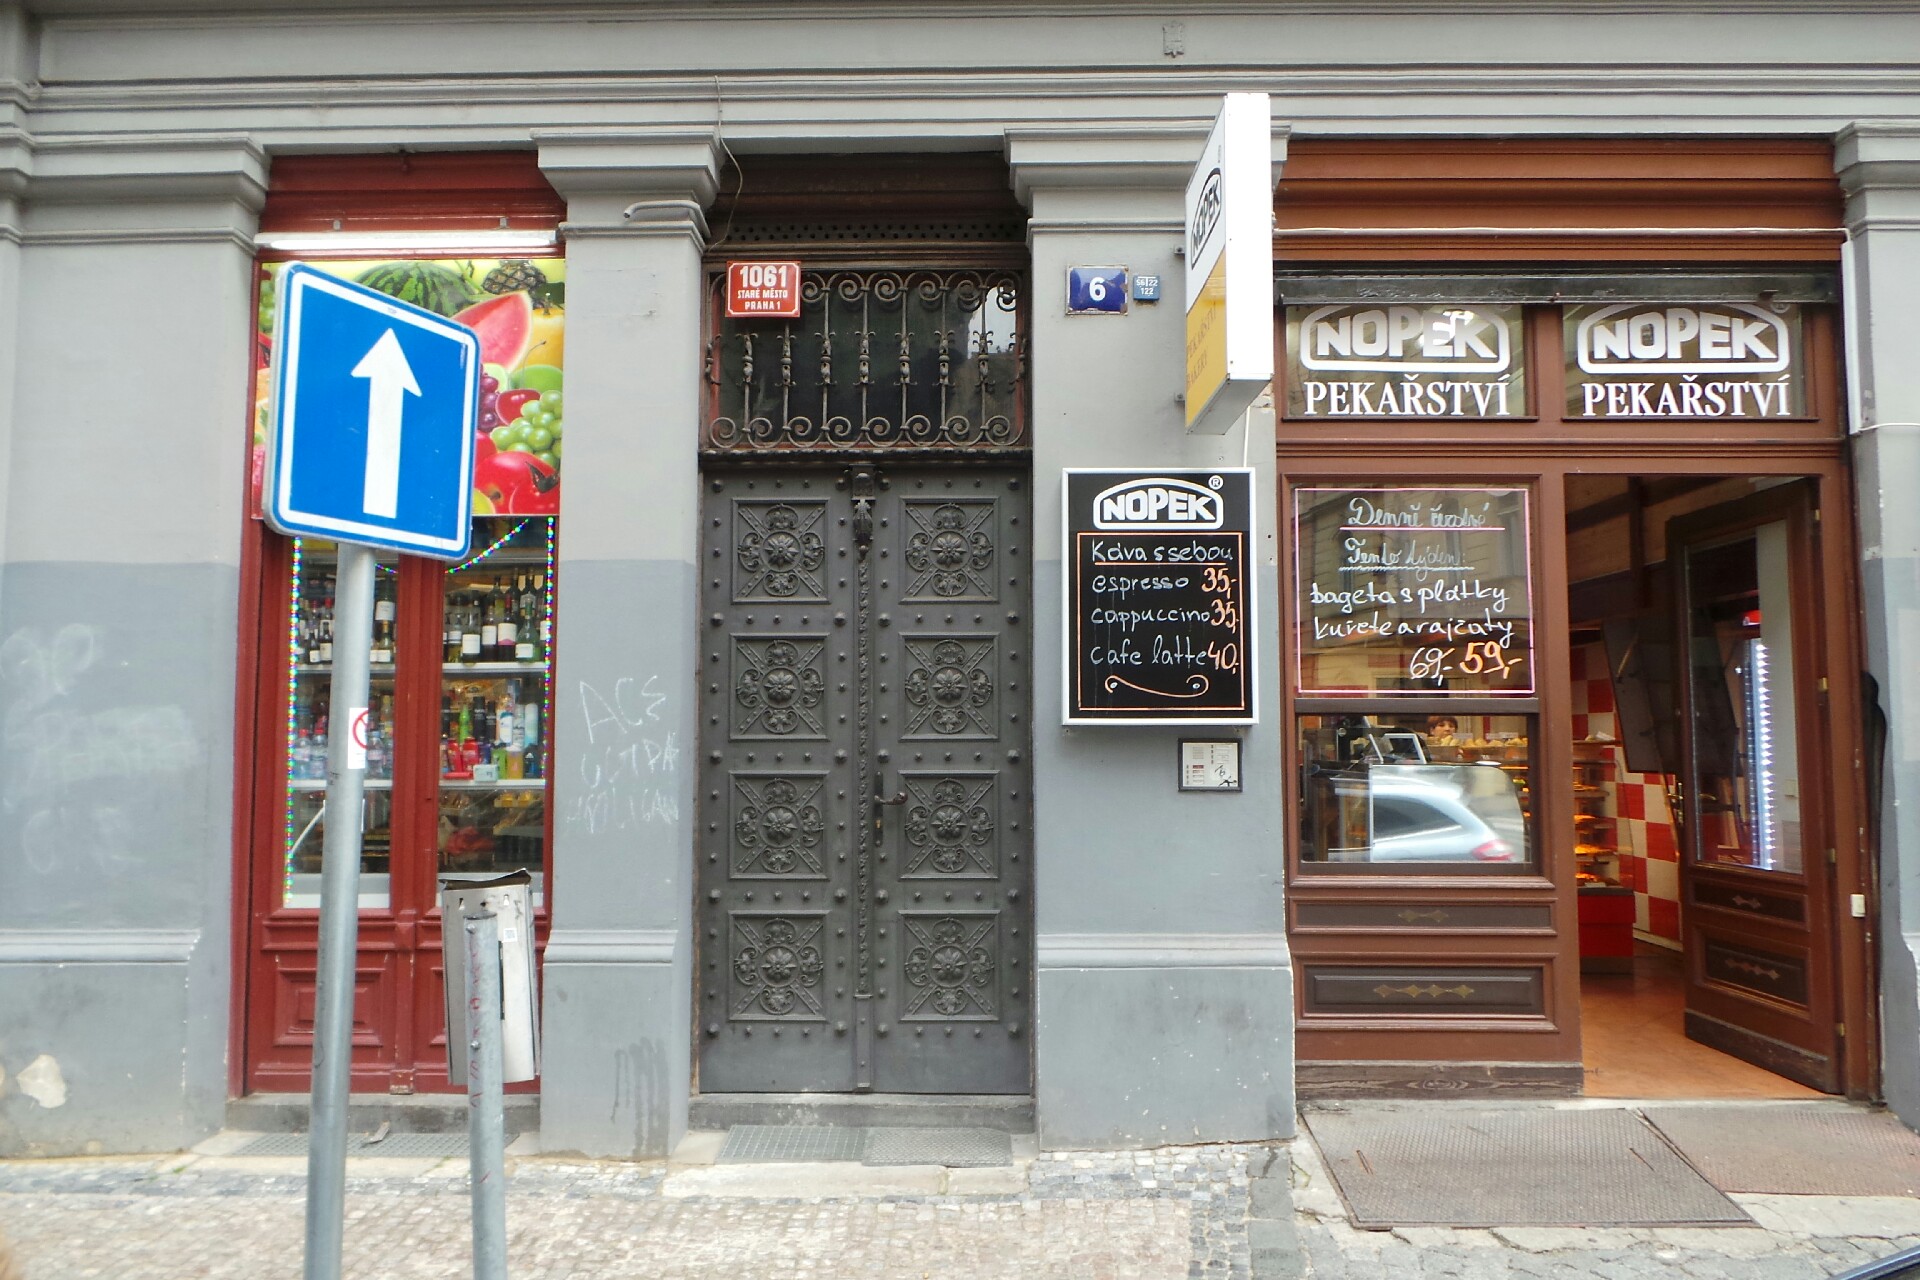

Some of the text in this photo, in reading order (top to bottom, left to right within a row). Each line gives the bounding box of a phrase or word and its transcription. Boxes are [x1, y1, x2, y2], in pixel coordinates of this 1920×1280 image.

[740, 265, 787, 288] 1061
[1089, 277, 1106, 301] 6
[737, 288, 788, 299] STARÉ MĚSTO
[744, 301, 781, 310] PRAHA 1
[1316, 306, 1499, 358] NOPEK
[1592, 307, 1778, 360] NOPEK
[1303, 373, 1511, 417] PEKAŘSTVÍ
[1581, 374, 1791, 417] PEKAŘSTVÍ
[1103, 488, 1217, 521] NOPEK
[1091, 538, 1148, 562] Káva
[1091, 575, 1190, 600] espresso
[1310, 581, 1397, 614] bageta
[1419, 579, 1510, 613] plátky
[1152, 634, 1207, 667] latte
